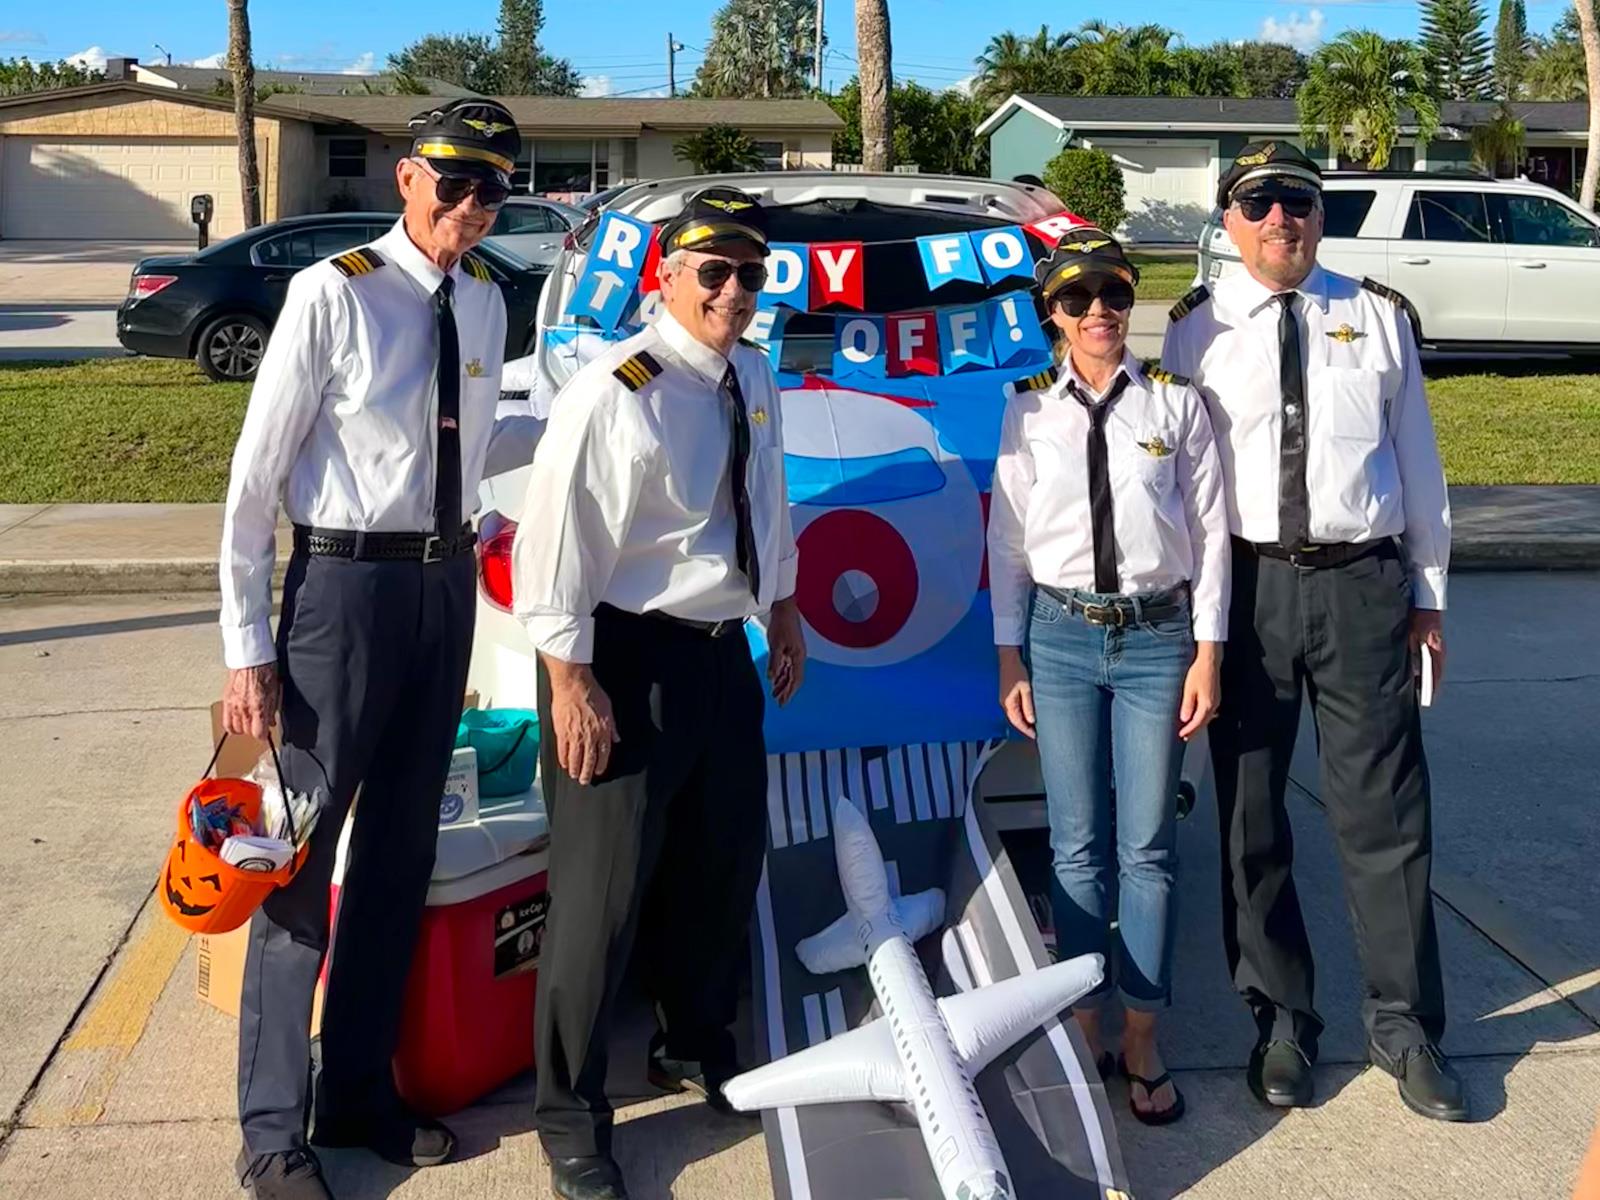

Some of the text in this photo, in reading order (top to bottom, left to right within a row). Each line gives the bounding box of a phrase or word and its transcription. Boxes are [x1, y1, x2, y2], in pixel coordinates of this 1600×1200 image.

[597, 216, 1086, 293] RDY FOR
[593, 271, 1023, 363] TAE OFF!
